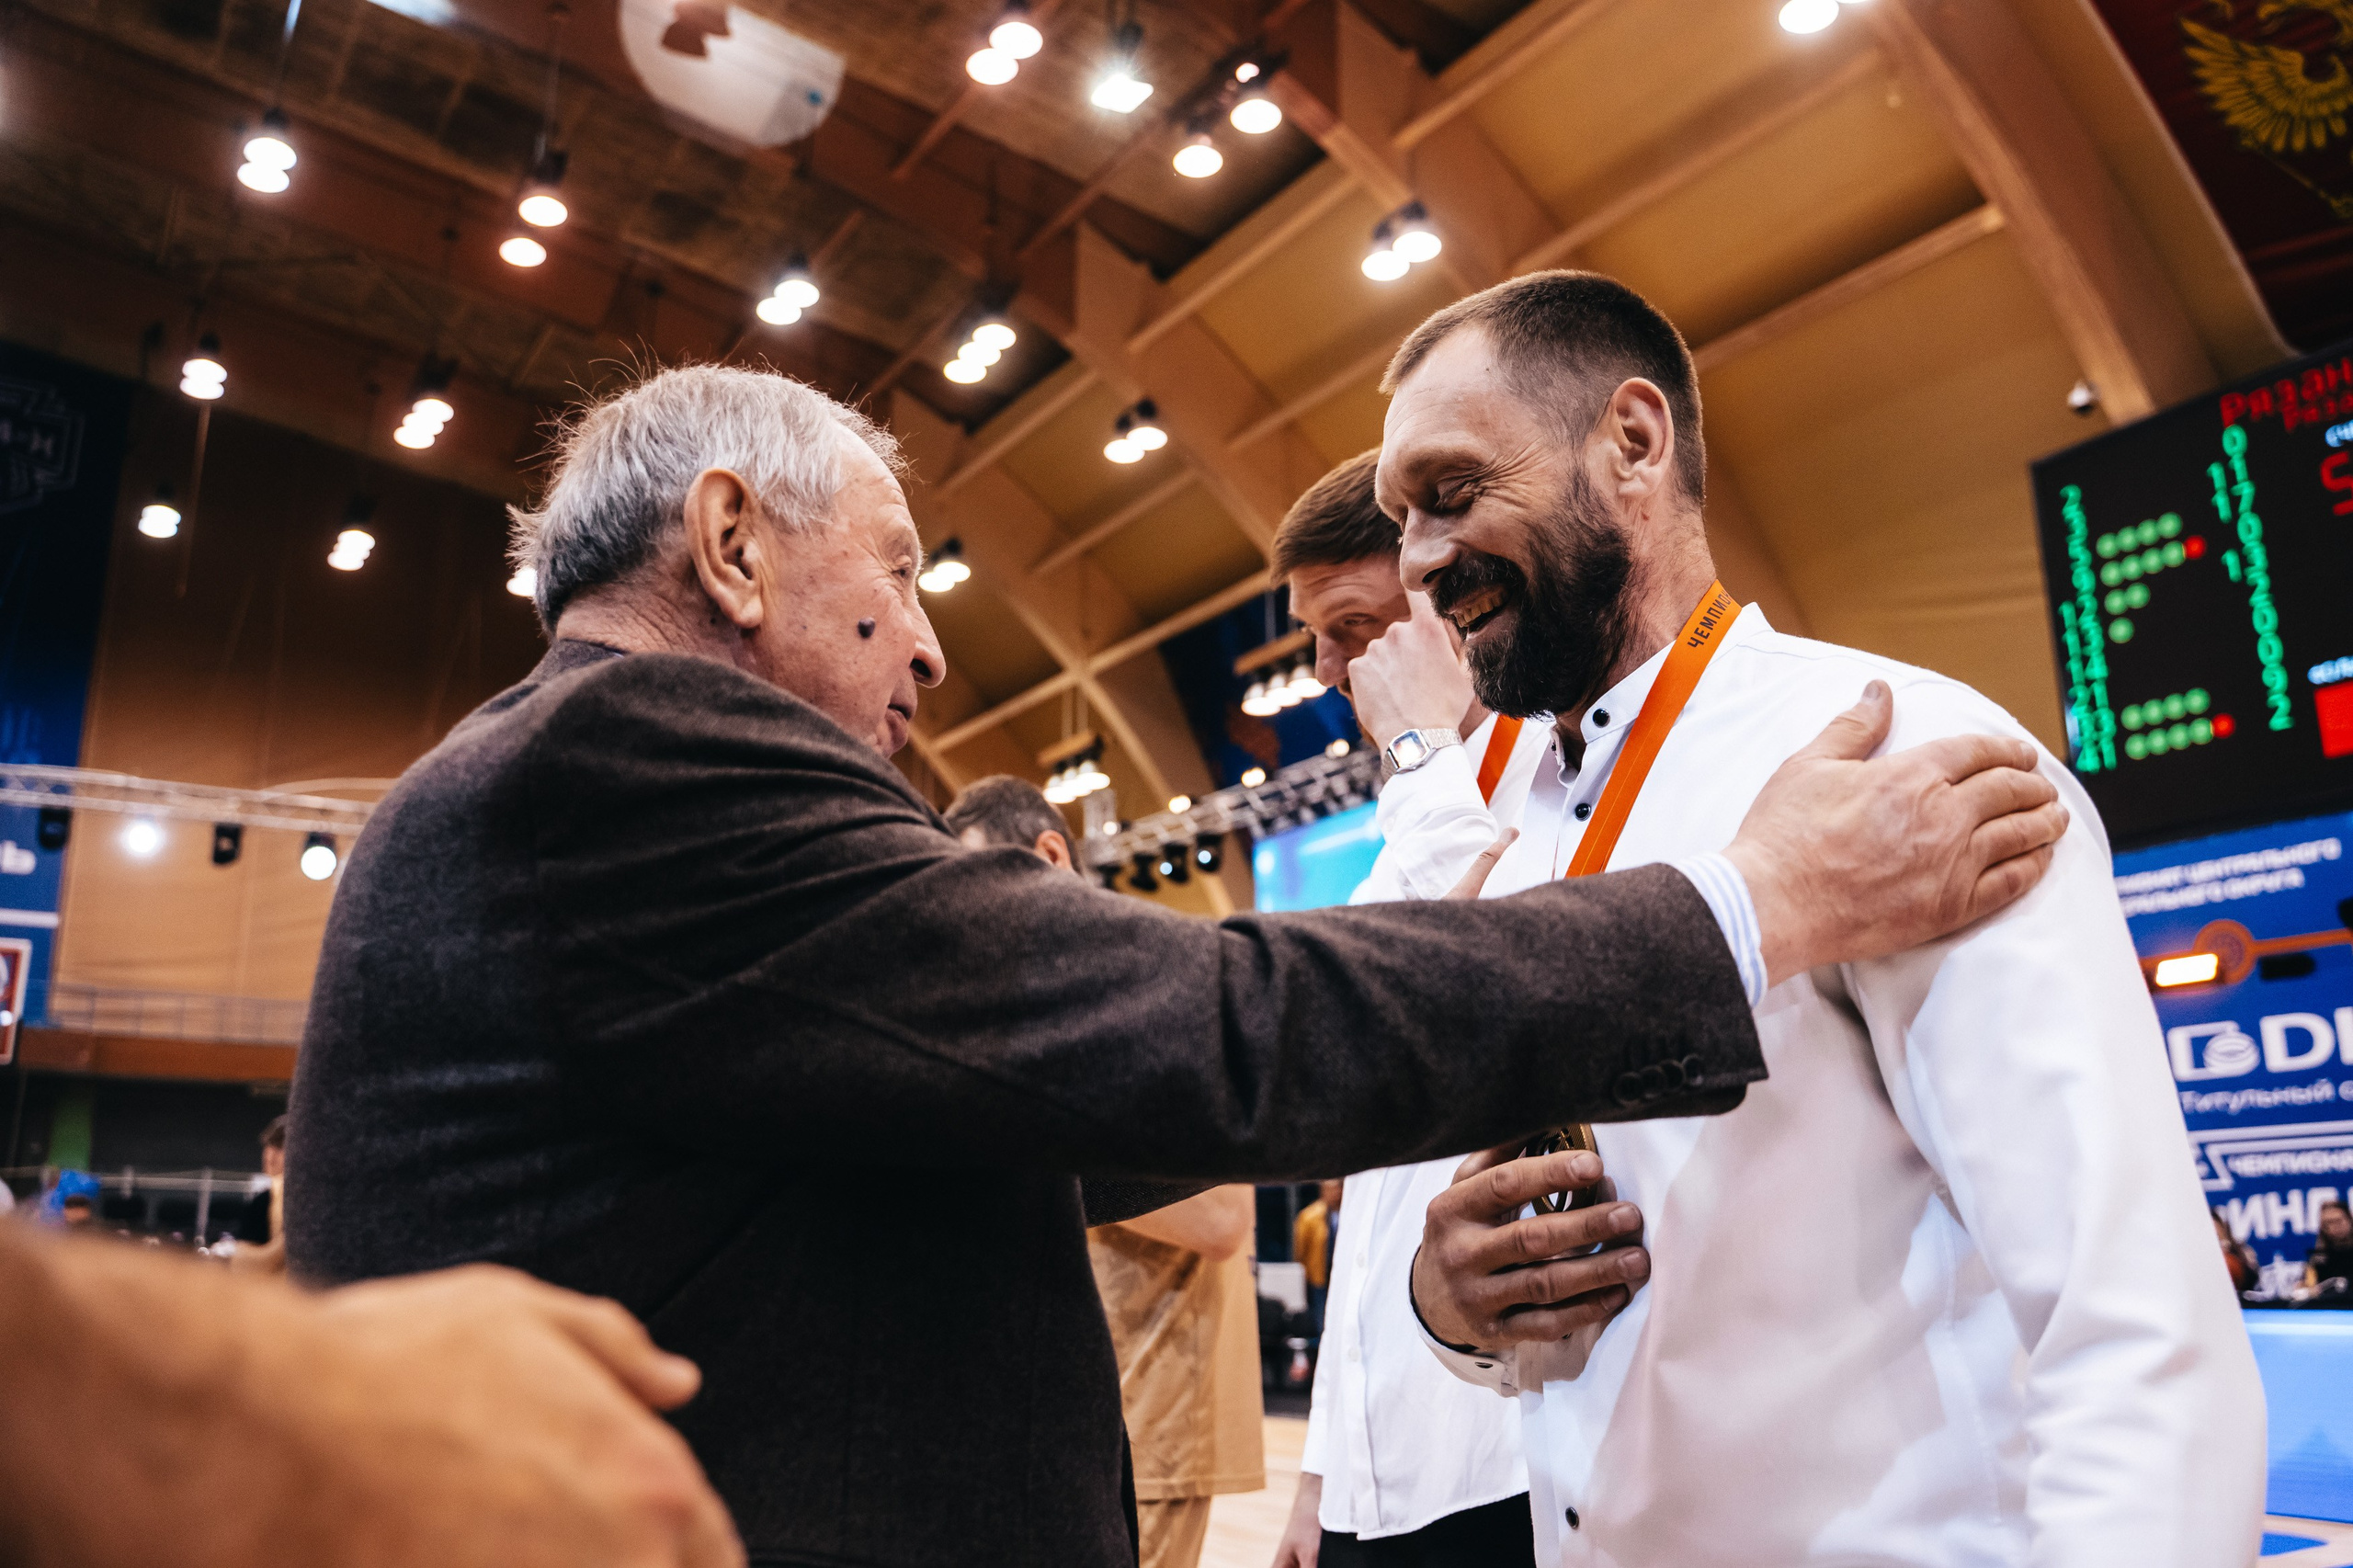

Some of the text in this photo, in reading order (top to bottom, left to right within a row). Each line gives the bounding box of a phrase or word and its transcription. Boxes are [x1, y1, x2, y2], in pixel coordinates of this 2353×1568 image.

[2222, 424, 2247, 458] 0
[2237, 511, 2263, 545] 0
[2253, 602, 2279, 636] 0
[2257, 631, 2284, 666] 0
[2267, 692, 2296, 732] 2
